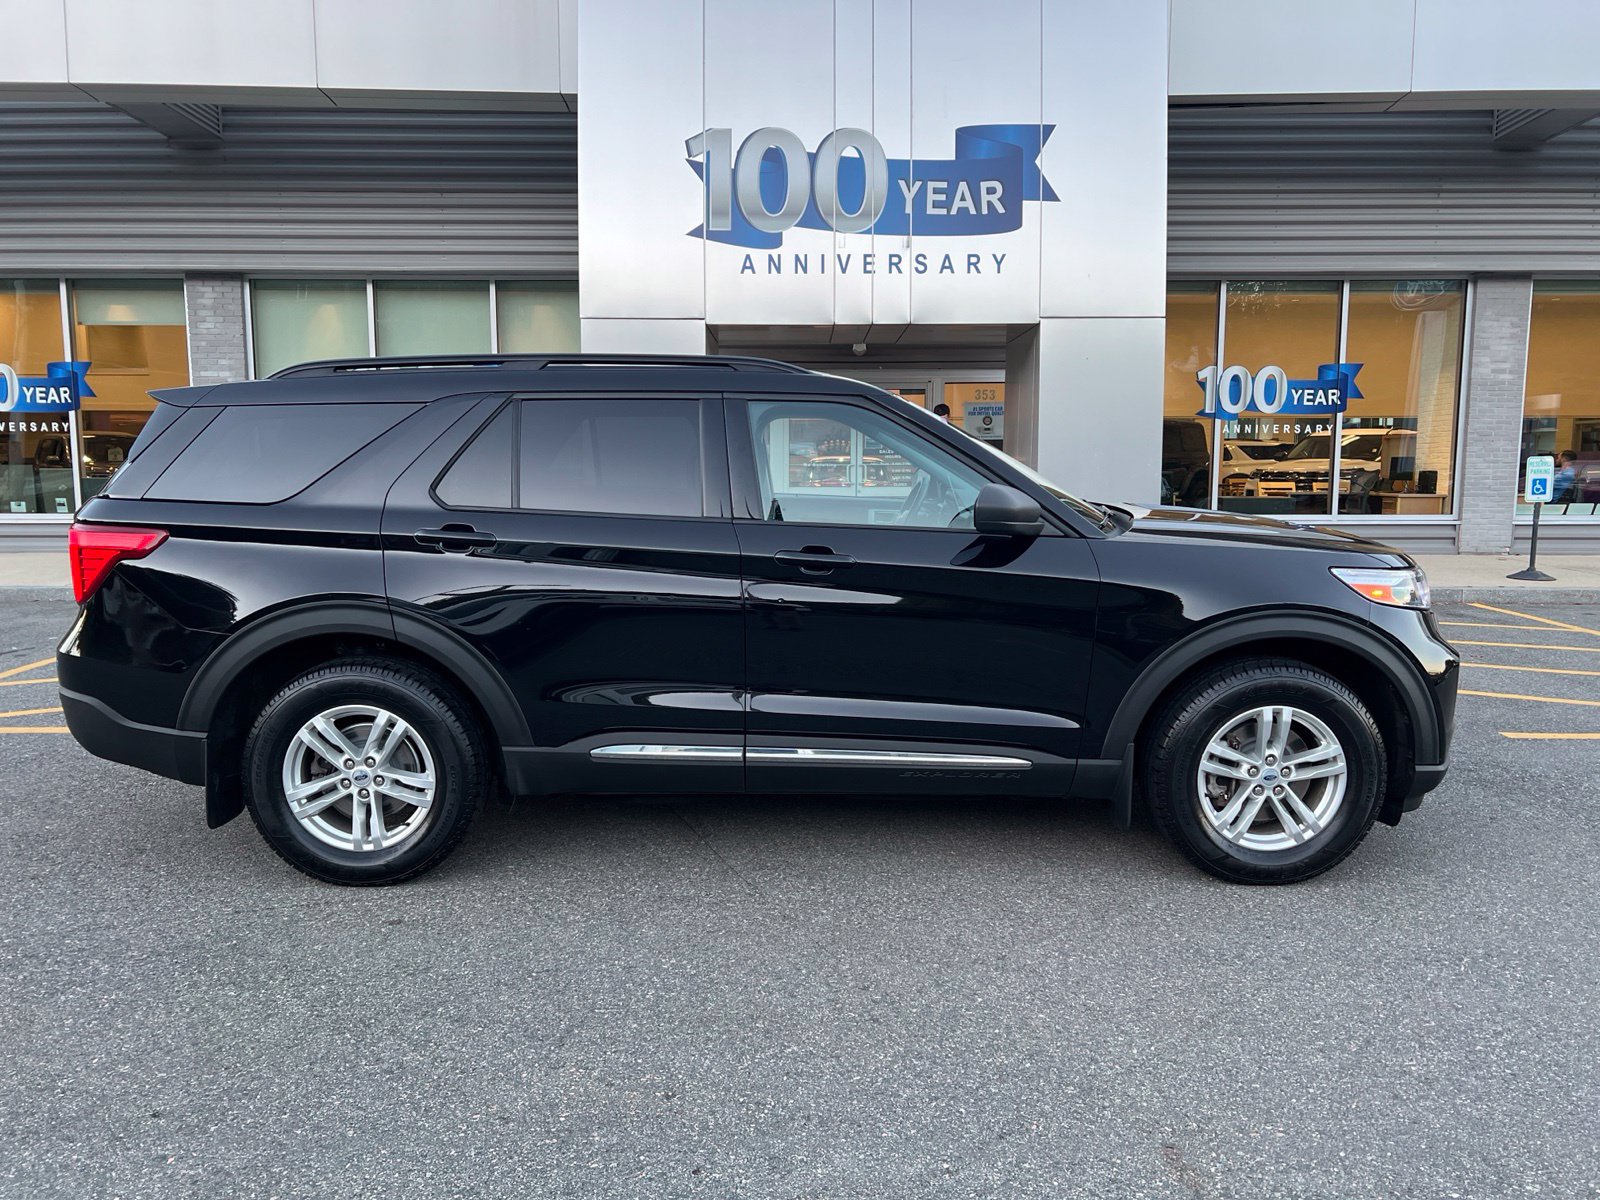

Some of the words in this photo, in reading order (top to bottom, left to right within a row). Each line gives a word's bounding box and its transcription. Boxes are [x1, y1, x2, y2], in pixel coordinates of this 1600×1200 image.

[685, 126, 888, 233] 100
[898, 180, 1006, 215] YEAR
[741, 254, 1007, 274] ANNIVERSARY
[22, 387, 72, 404] YEAR
[975, 389, 996, 400] 353
[1197, 365, 1288, 414] 100
[1291, 389, 1341, 406] YEAR
[1222, 424, 1333, 434] ANNIVERSARY
